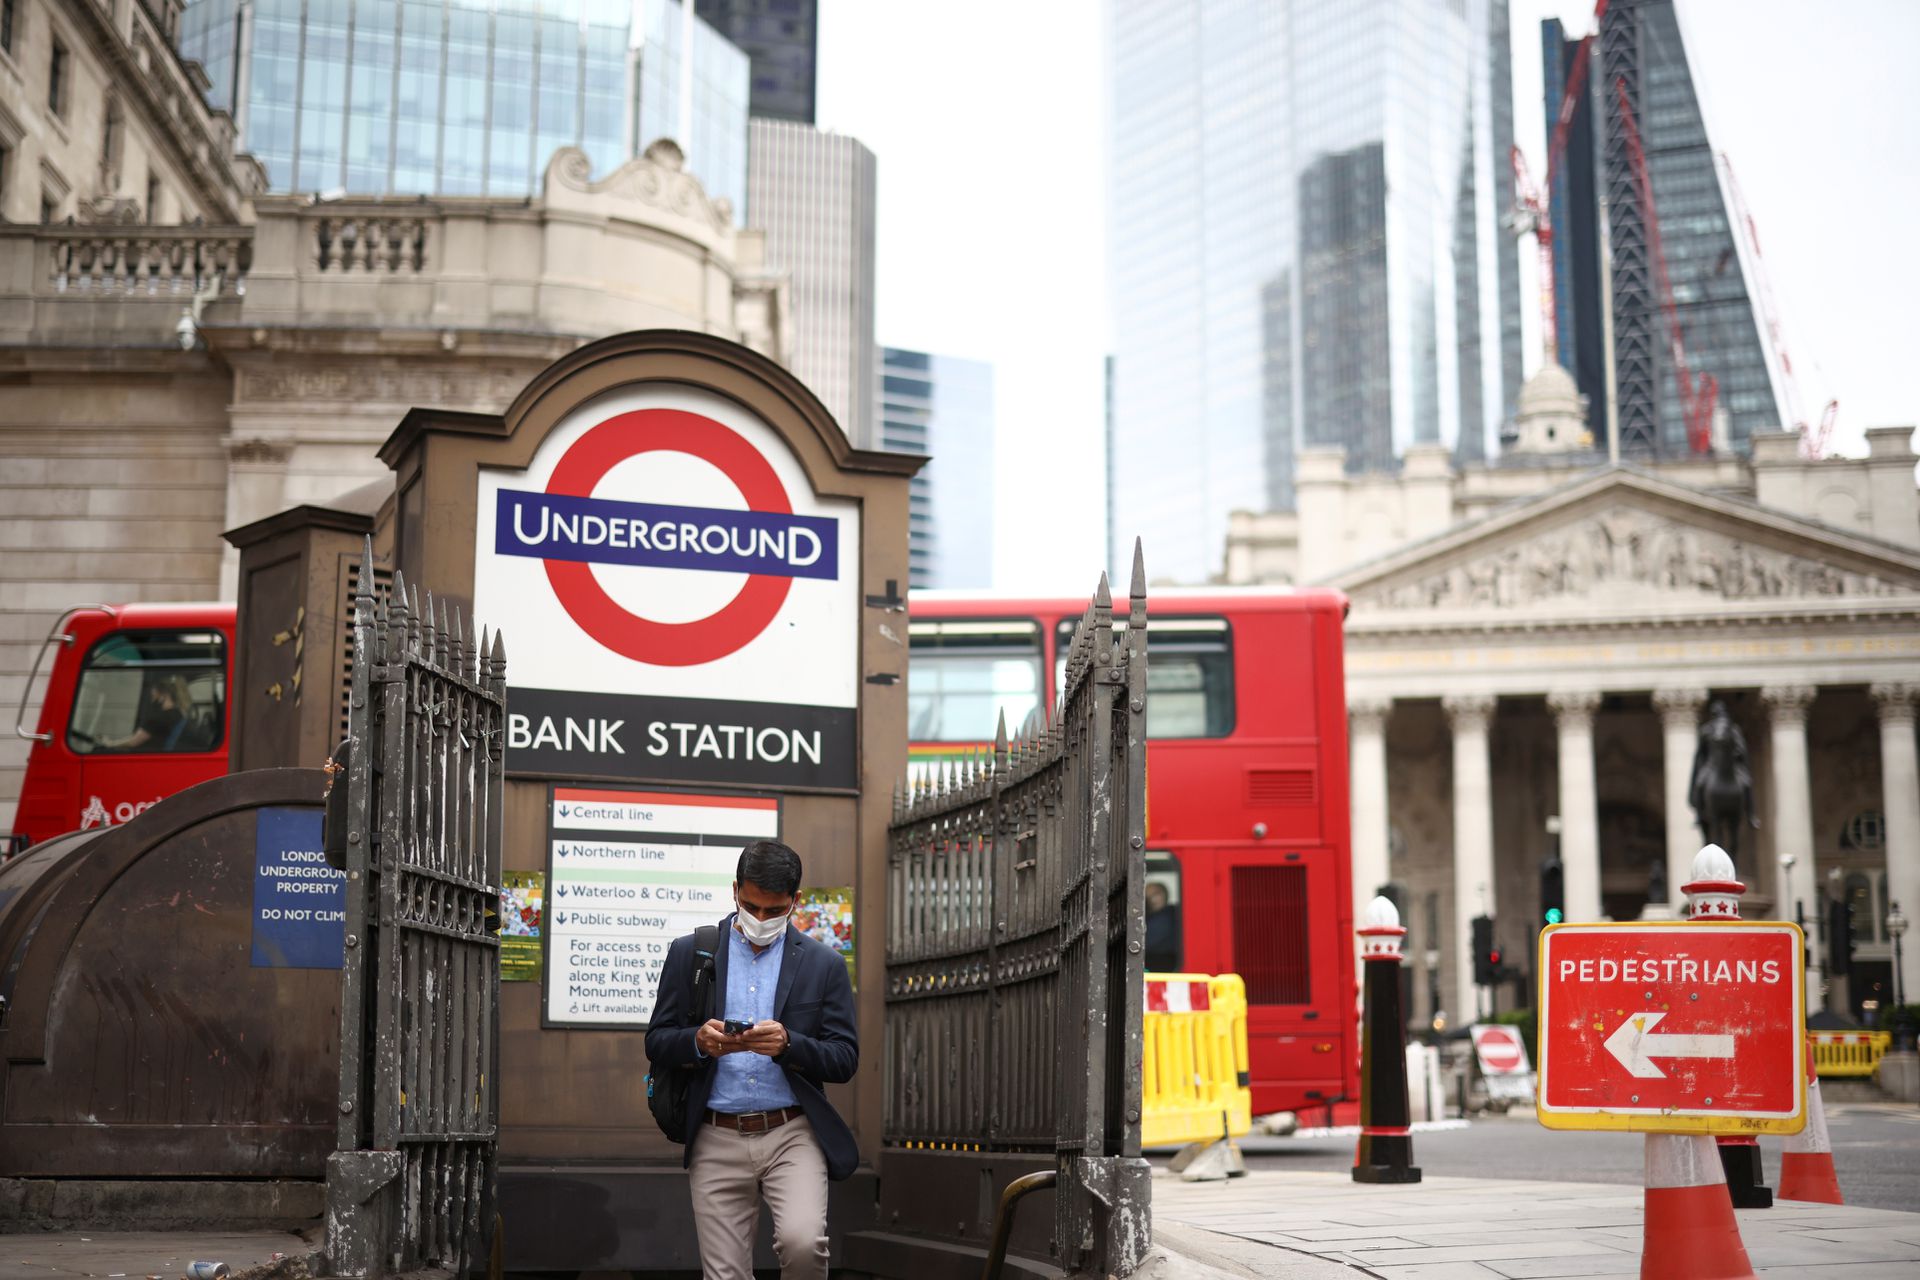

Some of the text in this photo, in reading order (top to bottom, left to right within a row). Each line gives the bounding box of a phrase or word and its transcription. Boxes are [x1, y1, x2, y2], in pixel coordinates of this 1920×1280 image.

[514, 504, 822, 566] UNDERGROUND
[508, 713, 821, 765] BANK STATION
[574, 806, 653, 821] Central line
[281, 850, 326, 863] LONDO
[572, 845, 665, 860] Northern line
[260, 865, 347, 879] UNDERGROUN
[276, 882, 338, 894] PROPERTY
[572, 885, 712, 902] Waterloo & City line
[262, 908, 346, 922] DO NOT CLIM
[571, 913, 667, 929] Public subway
[570, 939, 591, 952] For
[596, 942, 641, 952] access
[647, 943, 662, 953] to
[570, 954, 609, 967] Circle
[614, 956, 646, 968] lines
[569, 970, 606, 984] along
[611, 971, 640, 986] King
[1560, 959, 1781, 984] PEDESTRIANS
[569, 985, 642, 998] Monument
[583, 1002, 648, 1014] Lift available
